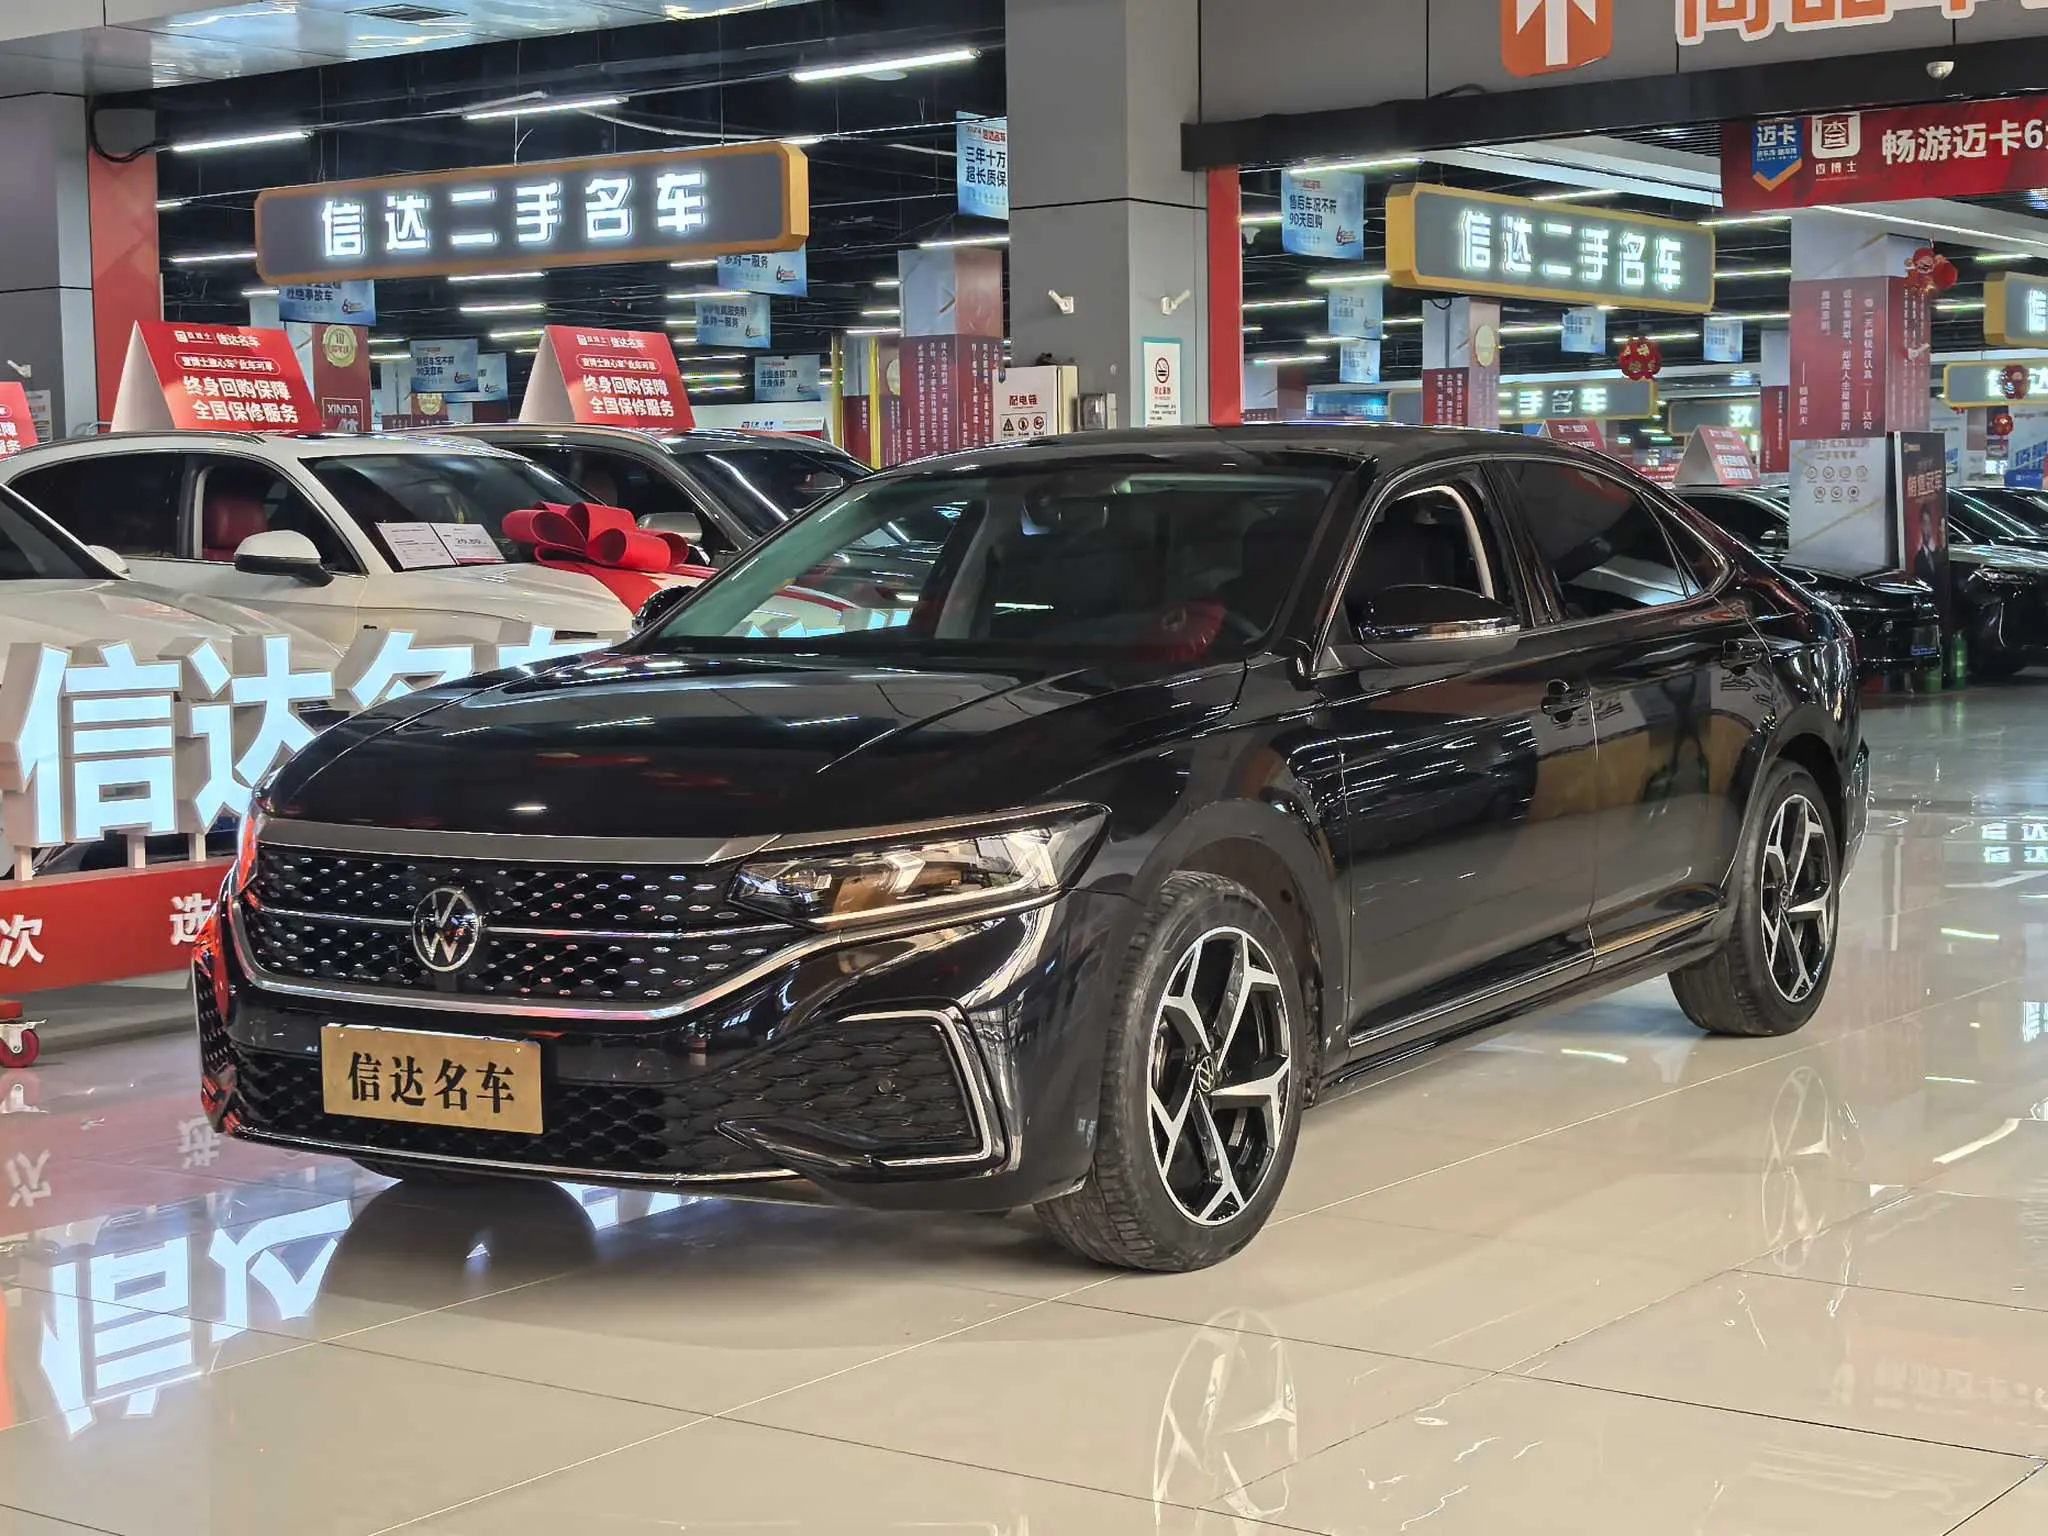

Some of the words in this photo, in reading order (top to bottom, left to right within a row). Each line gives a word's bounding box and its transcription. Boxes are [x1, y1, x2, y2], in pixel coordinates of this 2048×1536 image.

[1757, 123, 1798, 147] 迈卡
[1881, 118, 2048, 166] 畅游迈卡6
[321, 172, 706, 258] 信达二手名车
[1460, 208, 1683, 292] 信达二手名车
[184, 376, 291, 400] 终身回购保障
[583, 375, 669, 397] 终身回购保障
[192, 400, 298, 423] 全国保修服务
[328, 404, 358, 414] XINDA
[590, 397, 675, 417] 全国保修服务
[1009, 394, 1038, 406] 配电箱
[348, 1051, 515, 1114] 信达名车
